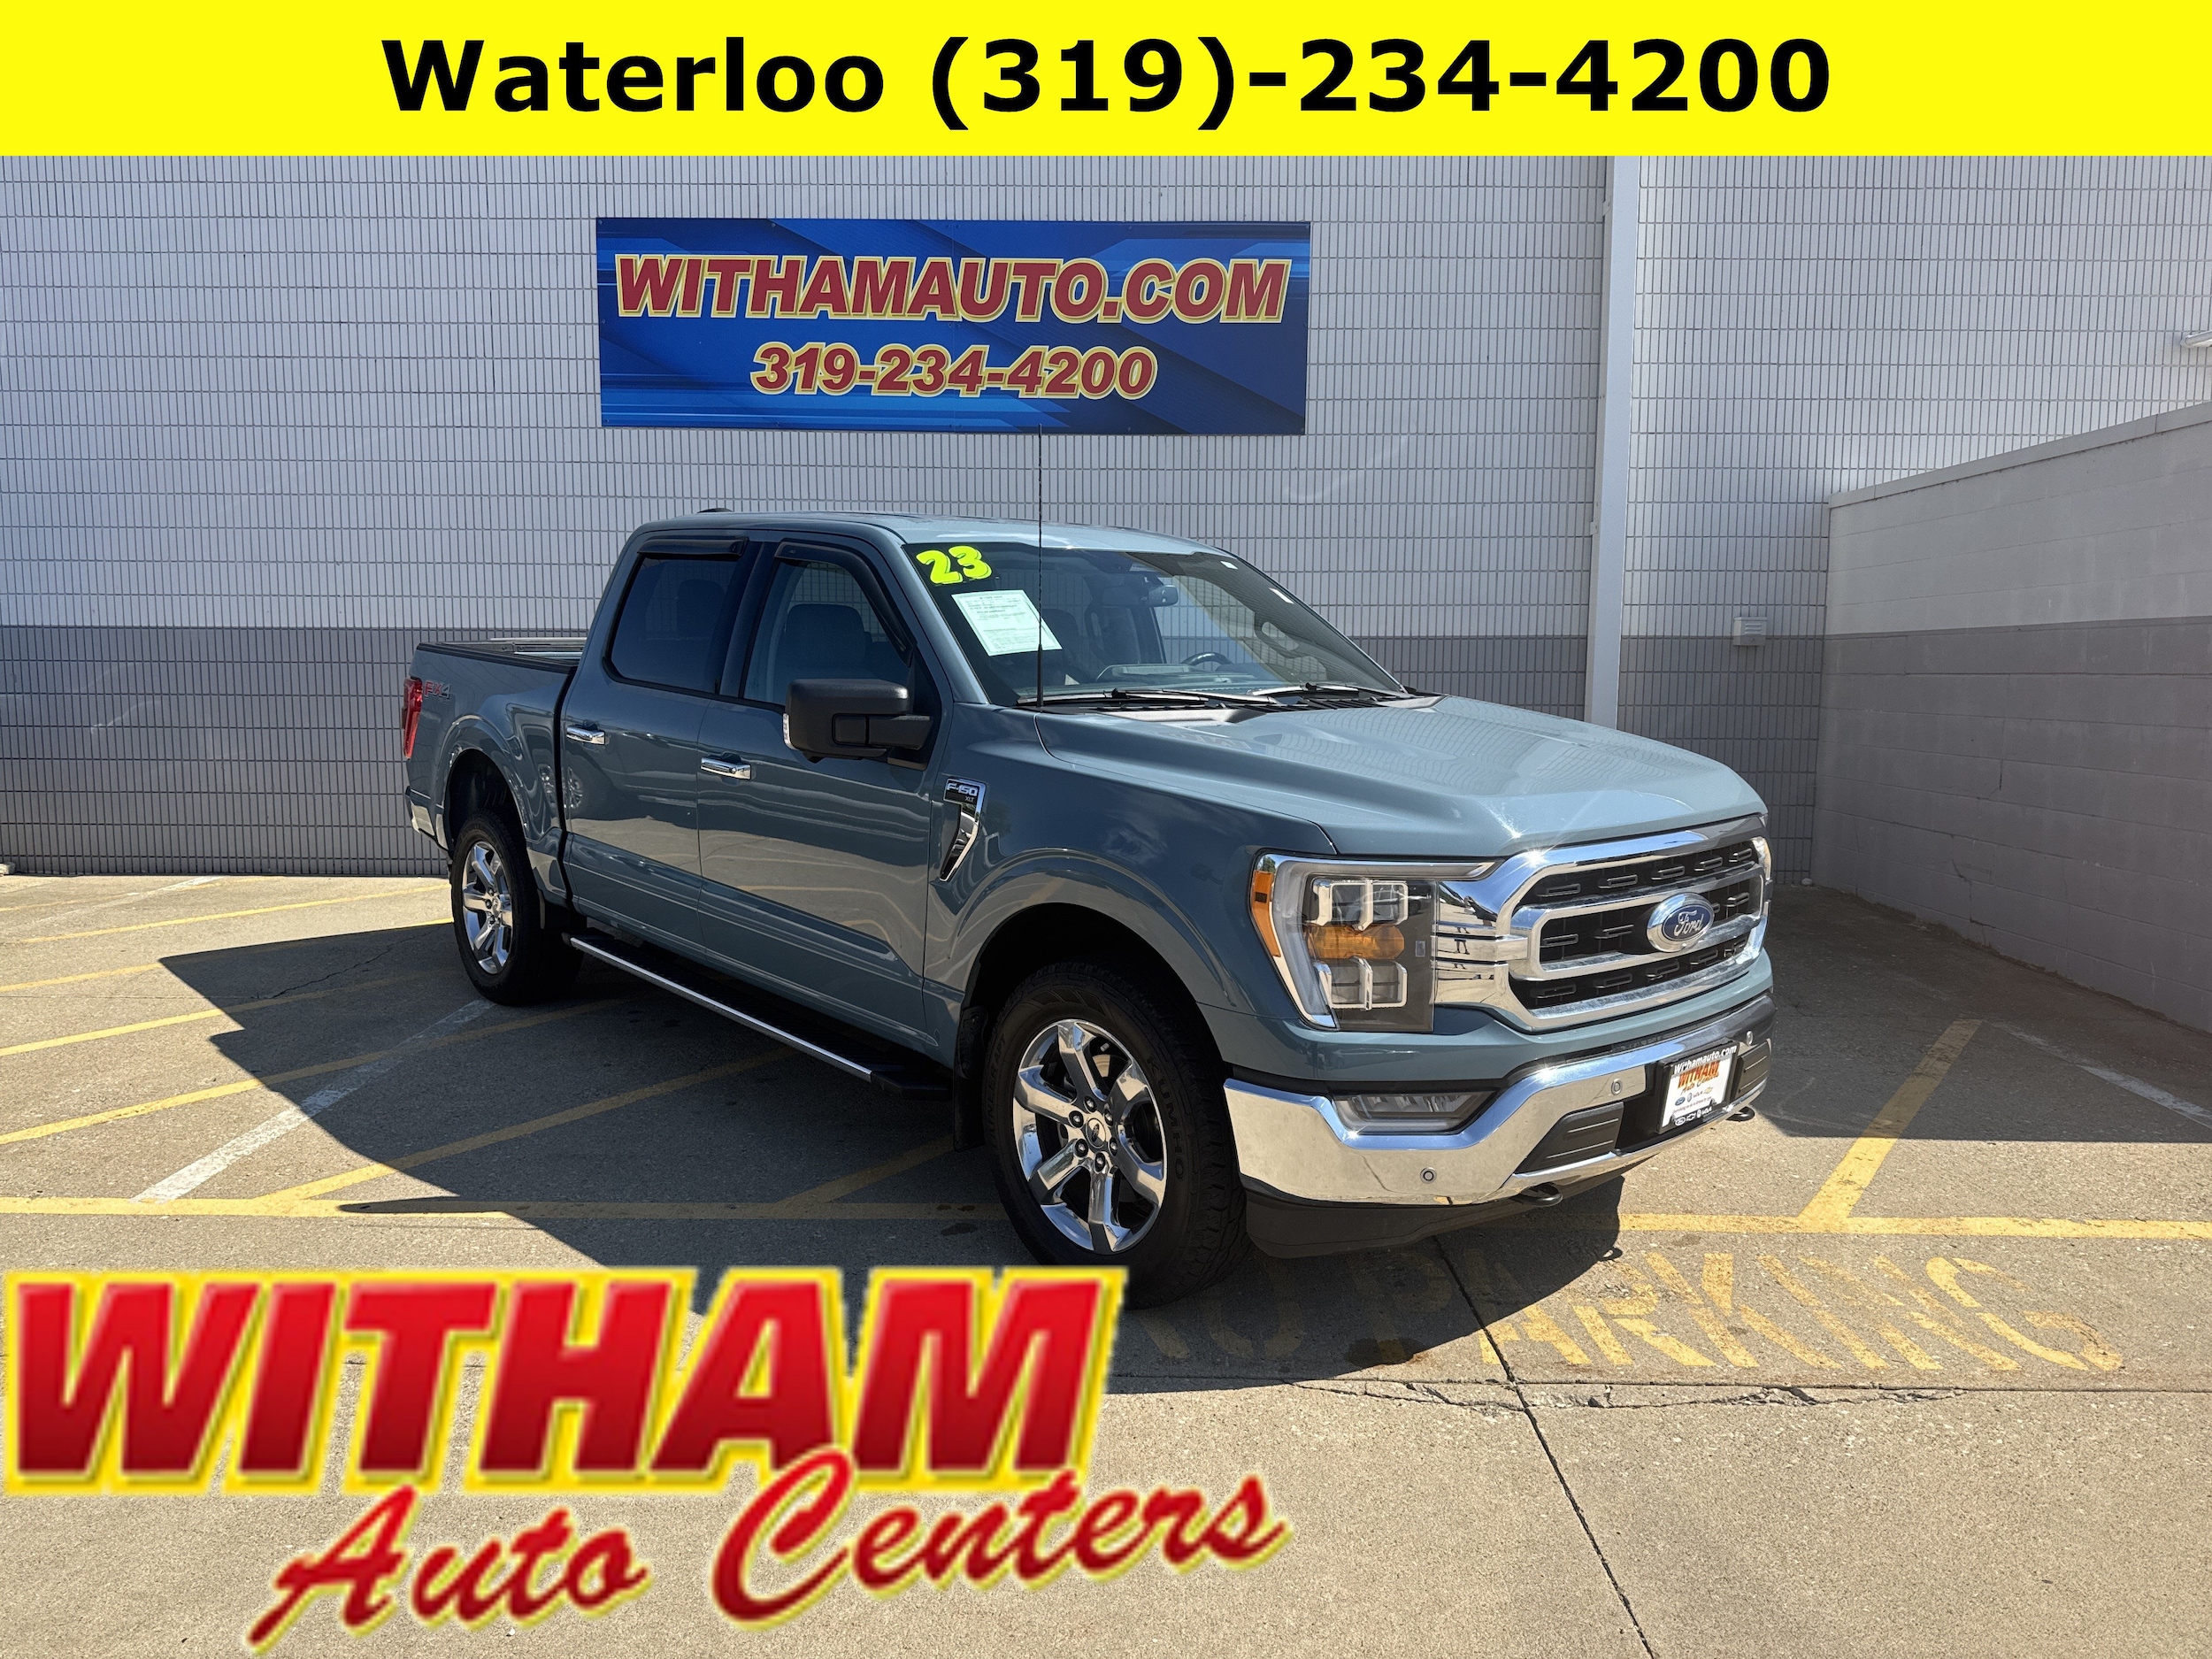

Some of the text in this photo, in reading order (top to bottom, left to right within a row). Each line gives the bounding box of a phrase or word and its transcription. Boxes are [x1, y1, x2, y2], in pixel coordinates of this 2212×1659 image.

[614, 255, 1291, 324] WITHAMAUTO.COM
[750, 342, 1157, 398] 319-234-4200
[916, 545, 992, 584] 23
[425, 680, 451, 699] FX4
[947, 782, 979, 797] F-150
[1673, 910, 1704, 937] Ford
[1678, 1060, 1721, 1088] WITHAM
